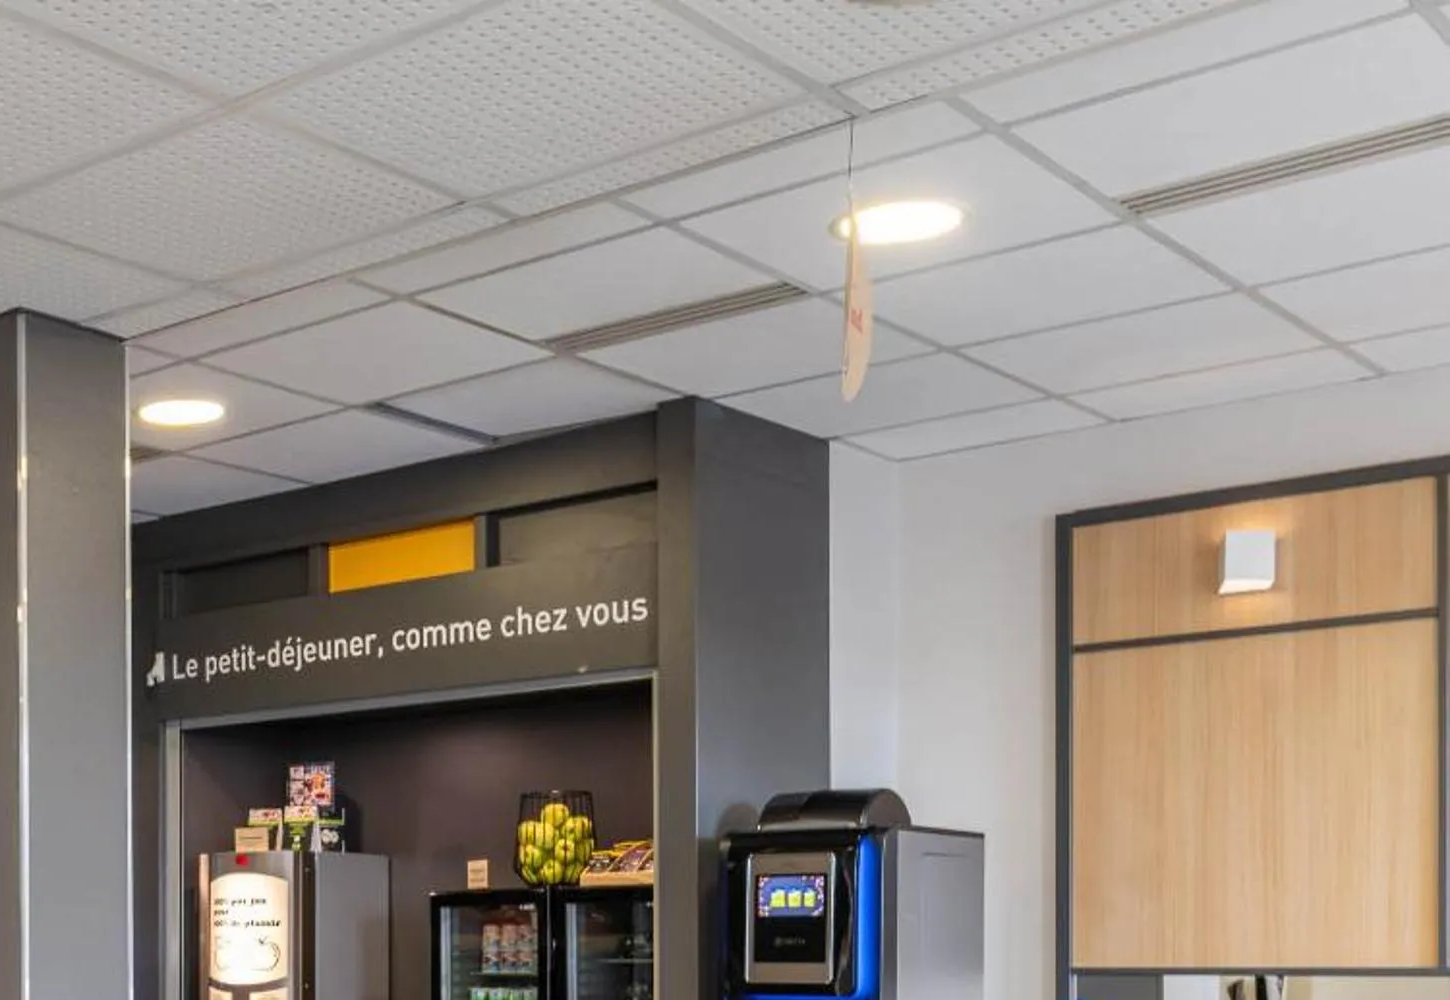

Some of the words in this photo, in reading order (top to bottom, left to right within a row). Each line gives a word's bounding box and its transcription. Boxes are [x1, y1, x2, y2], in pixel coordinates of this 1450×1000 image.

[172, 654, 199, 680] Le
[205, 636, 384, 683] petit-déjeuner,
[392, 618, 493, 652] comme
[501, 606, 568, 637] chez
[575, 597, 649, 628] vous
